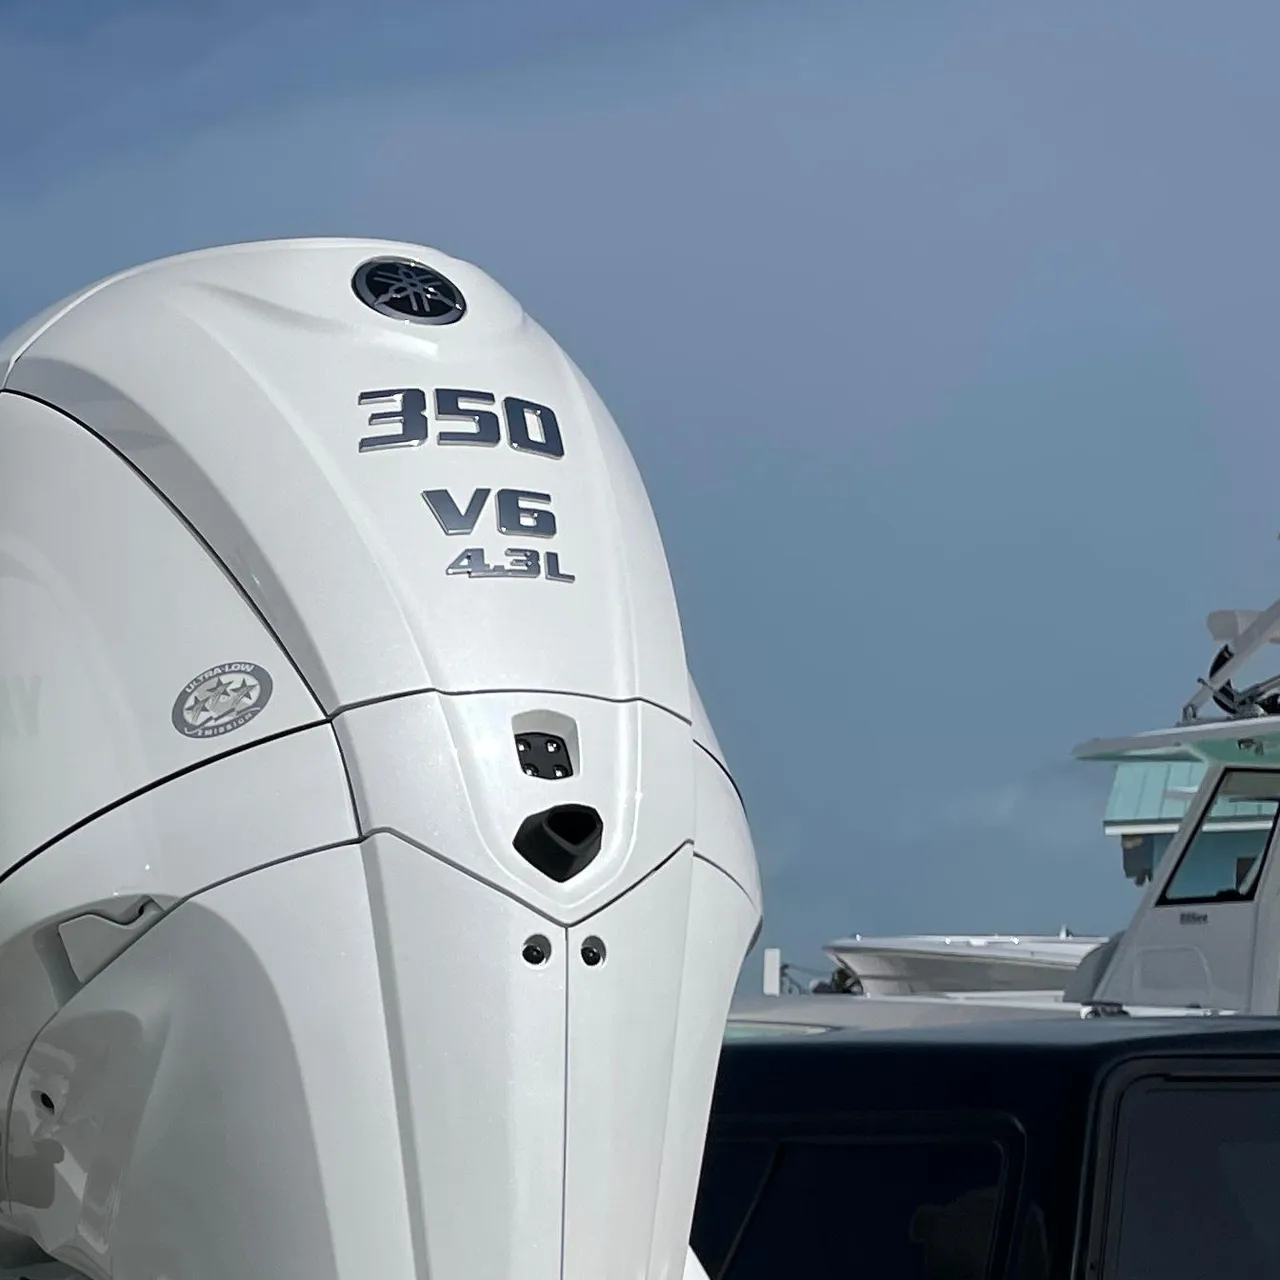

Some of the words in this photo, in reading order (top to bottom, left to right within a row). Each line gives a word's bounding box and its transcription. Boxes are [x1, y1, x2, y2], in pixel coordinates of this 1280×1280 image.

[358, 388, 564, 460] 350
[421, 488, 557, 539] V6
[445, 547, 575, 583] 4.3L
